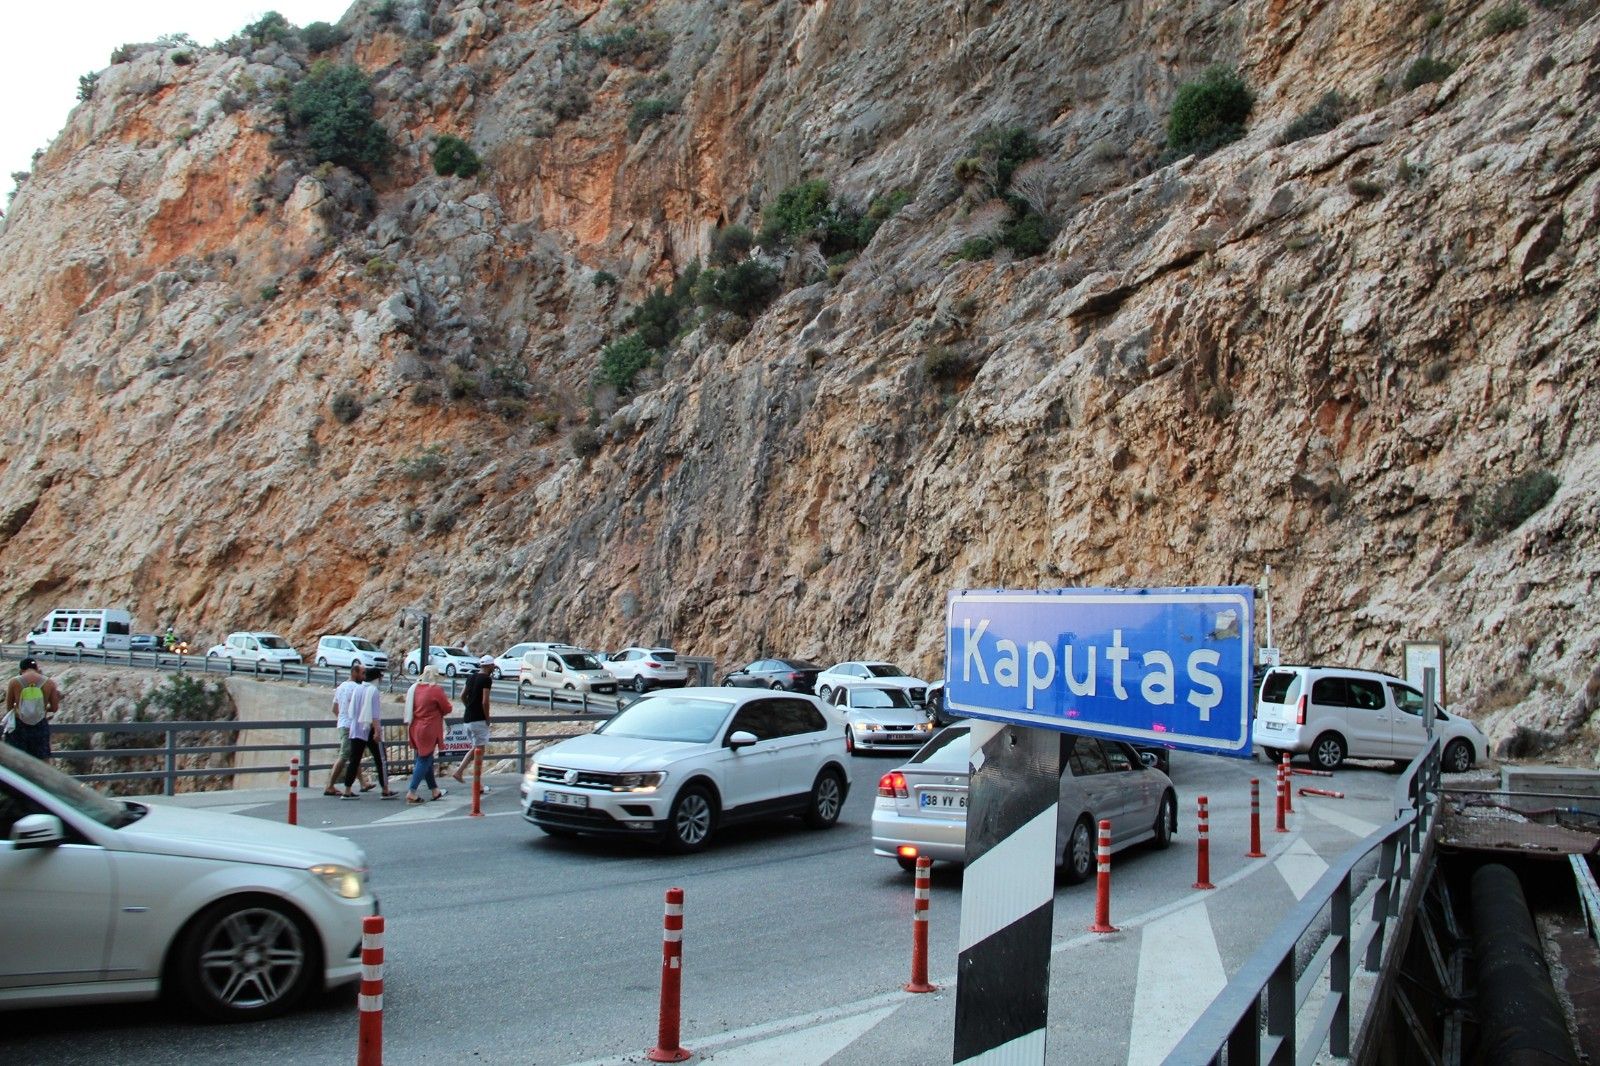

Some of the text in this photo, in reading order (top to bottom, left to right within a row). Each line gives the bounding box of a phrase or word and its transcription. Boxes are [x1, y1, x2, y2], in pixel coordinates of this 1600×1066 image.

[963, 618, 1223, 721] Kaputaş
[449, 742, 473, 750] PARKING
[926, 795, 937, 806] 38
